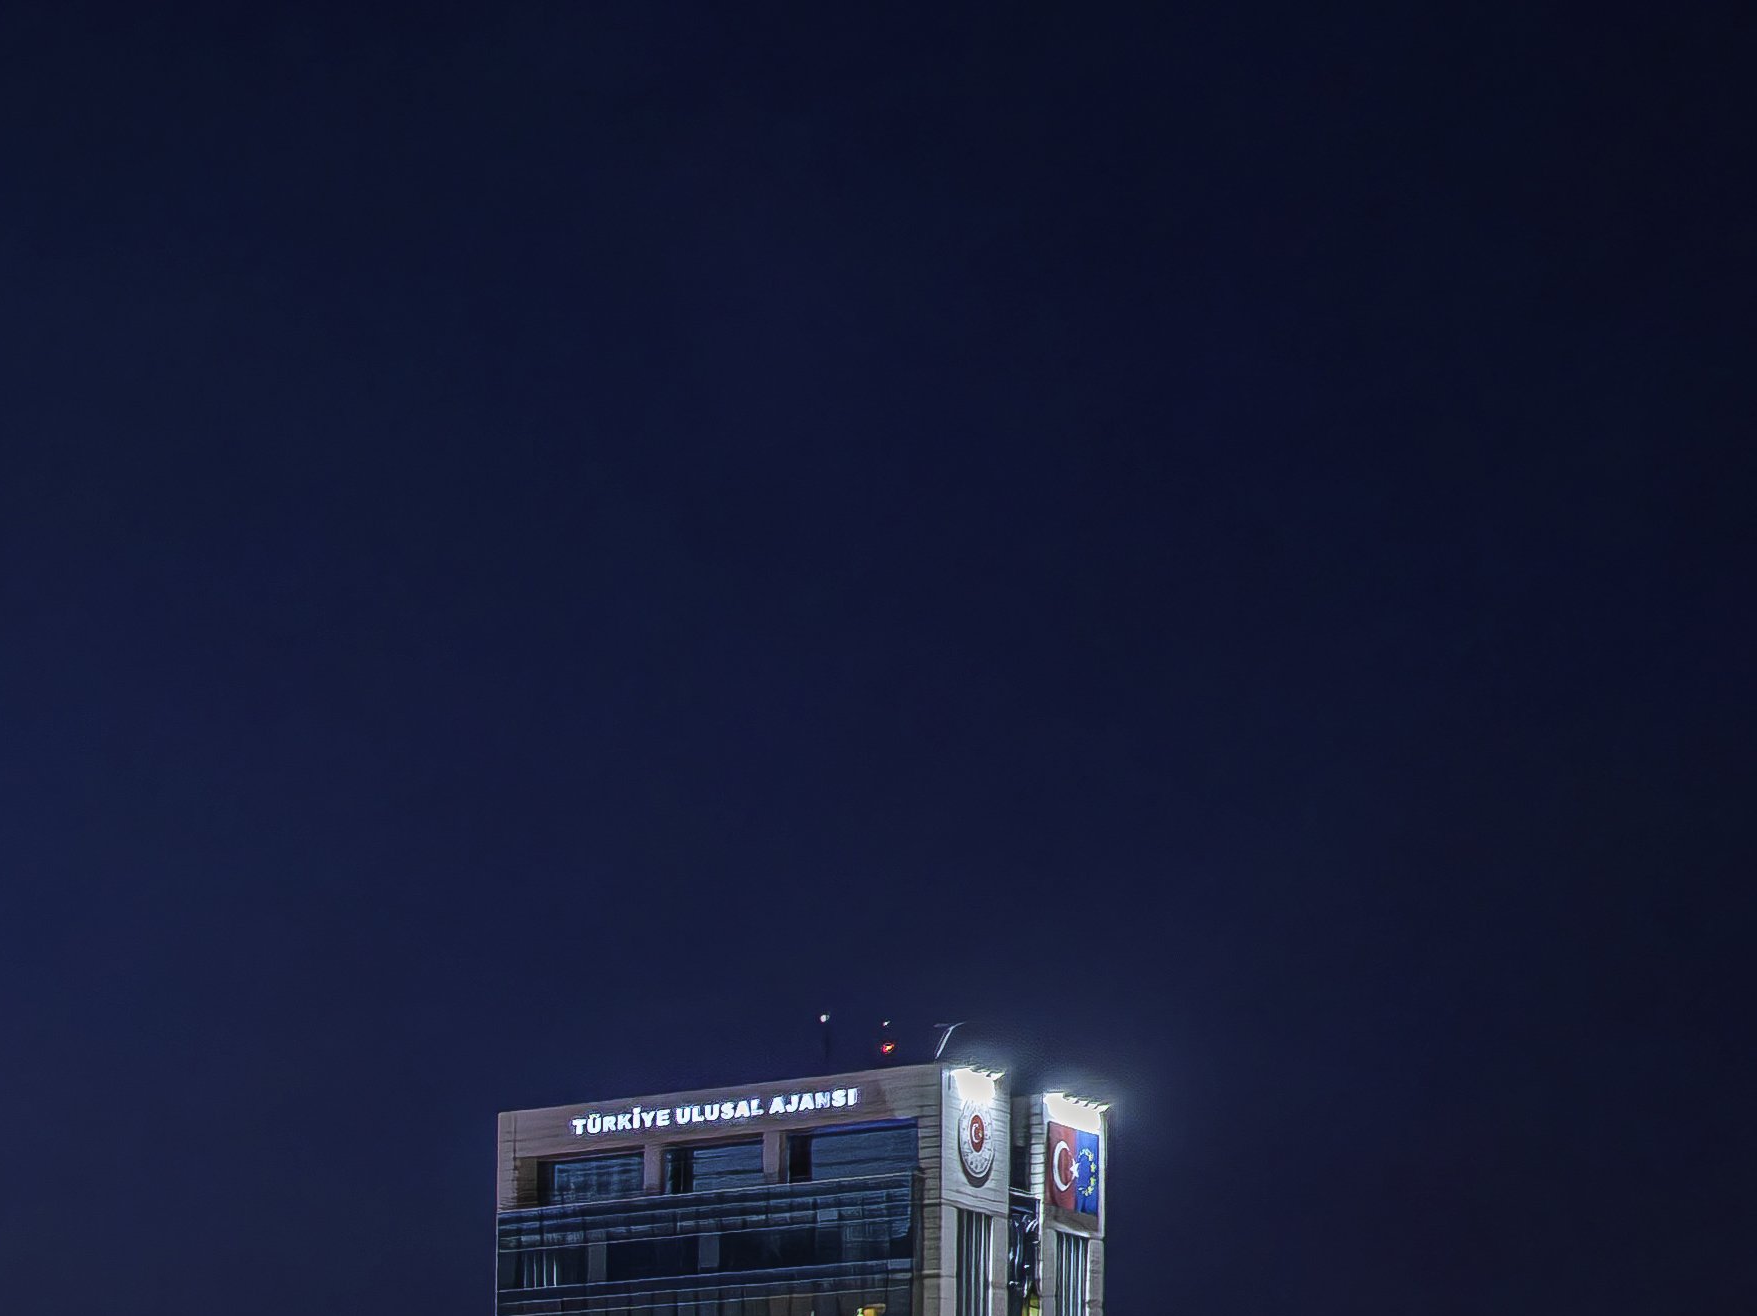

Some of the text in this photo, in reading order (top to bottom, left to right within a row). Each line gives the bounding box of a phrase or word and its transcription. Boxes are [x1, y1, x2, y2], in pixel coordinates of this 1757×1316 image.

[572, 1087, 859, 1135] TÜRKİYE ULUSAL AJANSI
